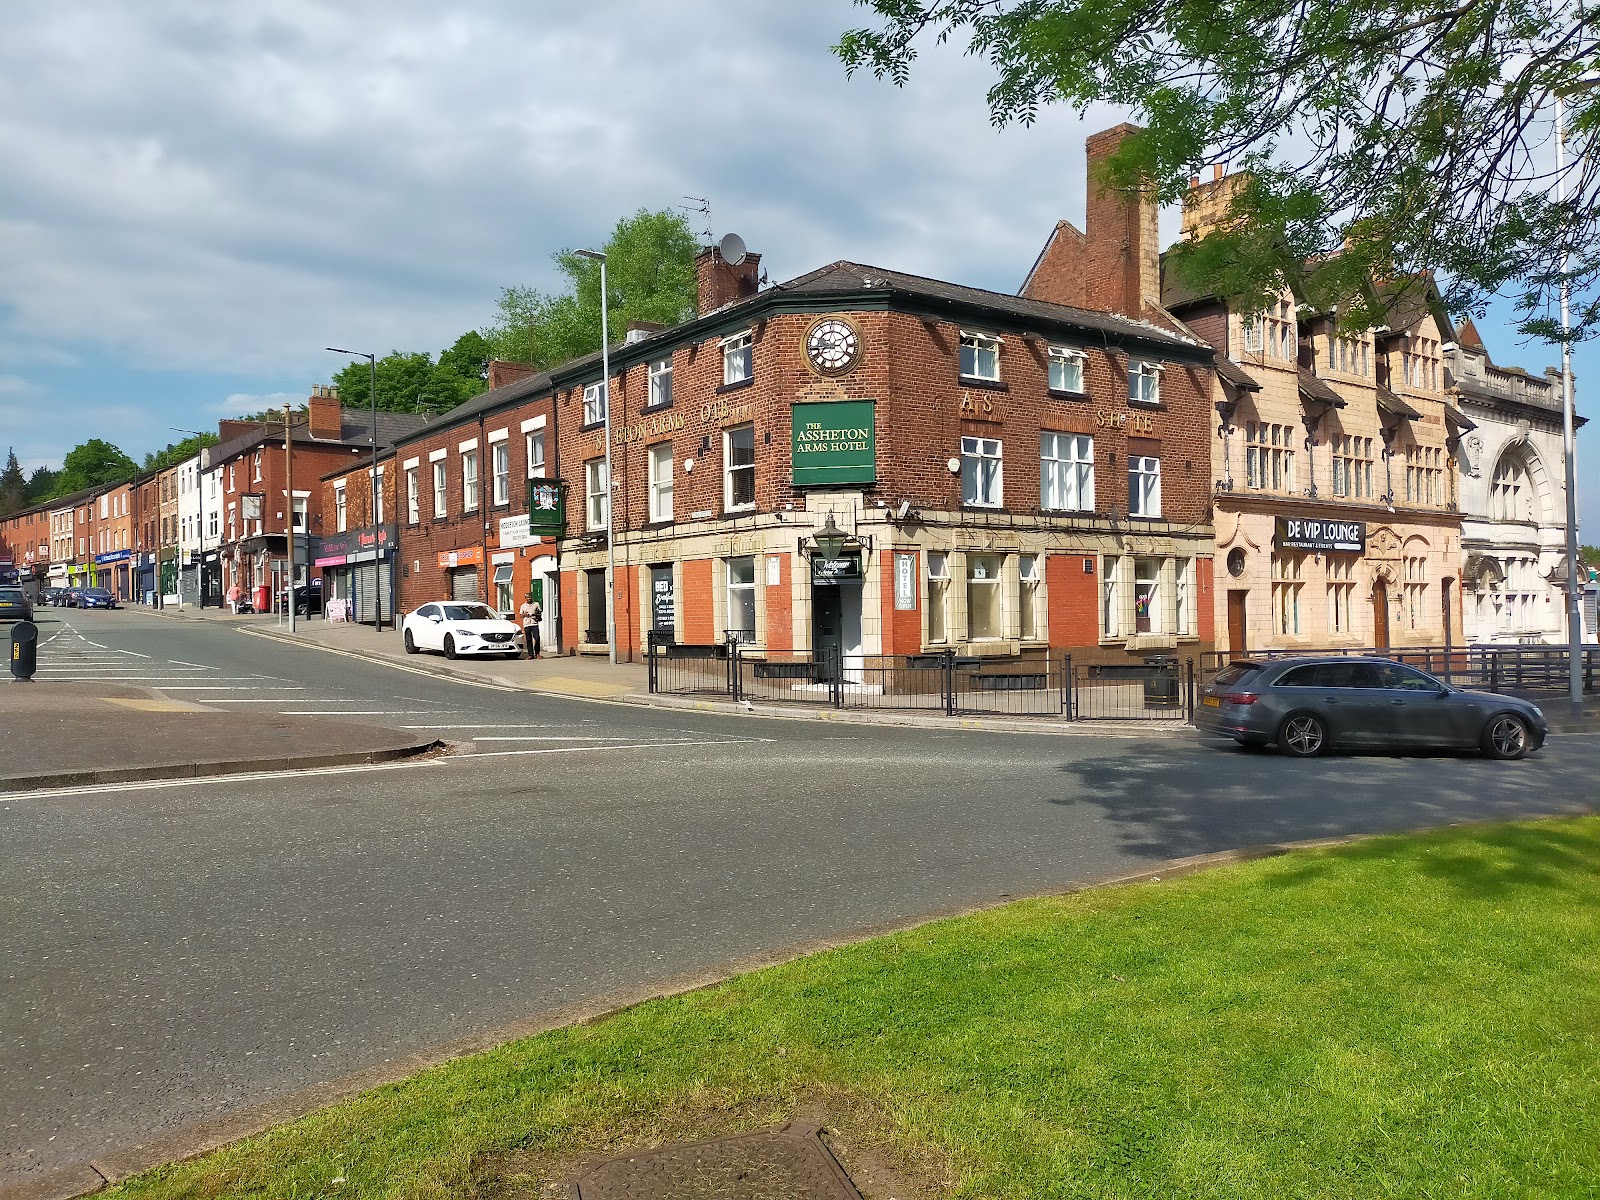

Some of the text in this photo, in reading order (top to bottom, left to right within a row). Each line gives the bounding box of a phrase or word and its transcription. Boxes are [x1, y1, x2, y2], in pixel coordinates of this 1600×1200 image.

[650, 413, 685, 435] ARMS
[797, 428, 869, 442] ASSHETON
[797, 441, 870, 453] ARMS HOTEL
[1288, 520, 1360, 541] DE VIP LOUNGE
[655, 580, 668, 592] BED
